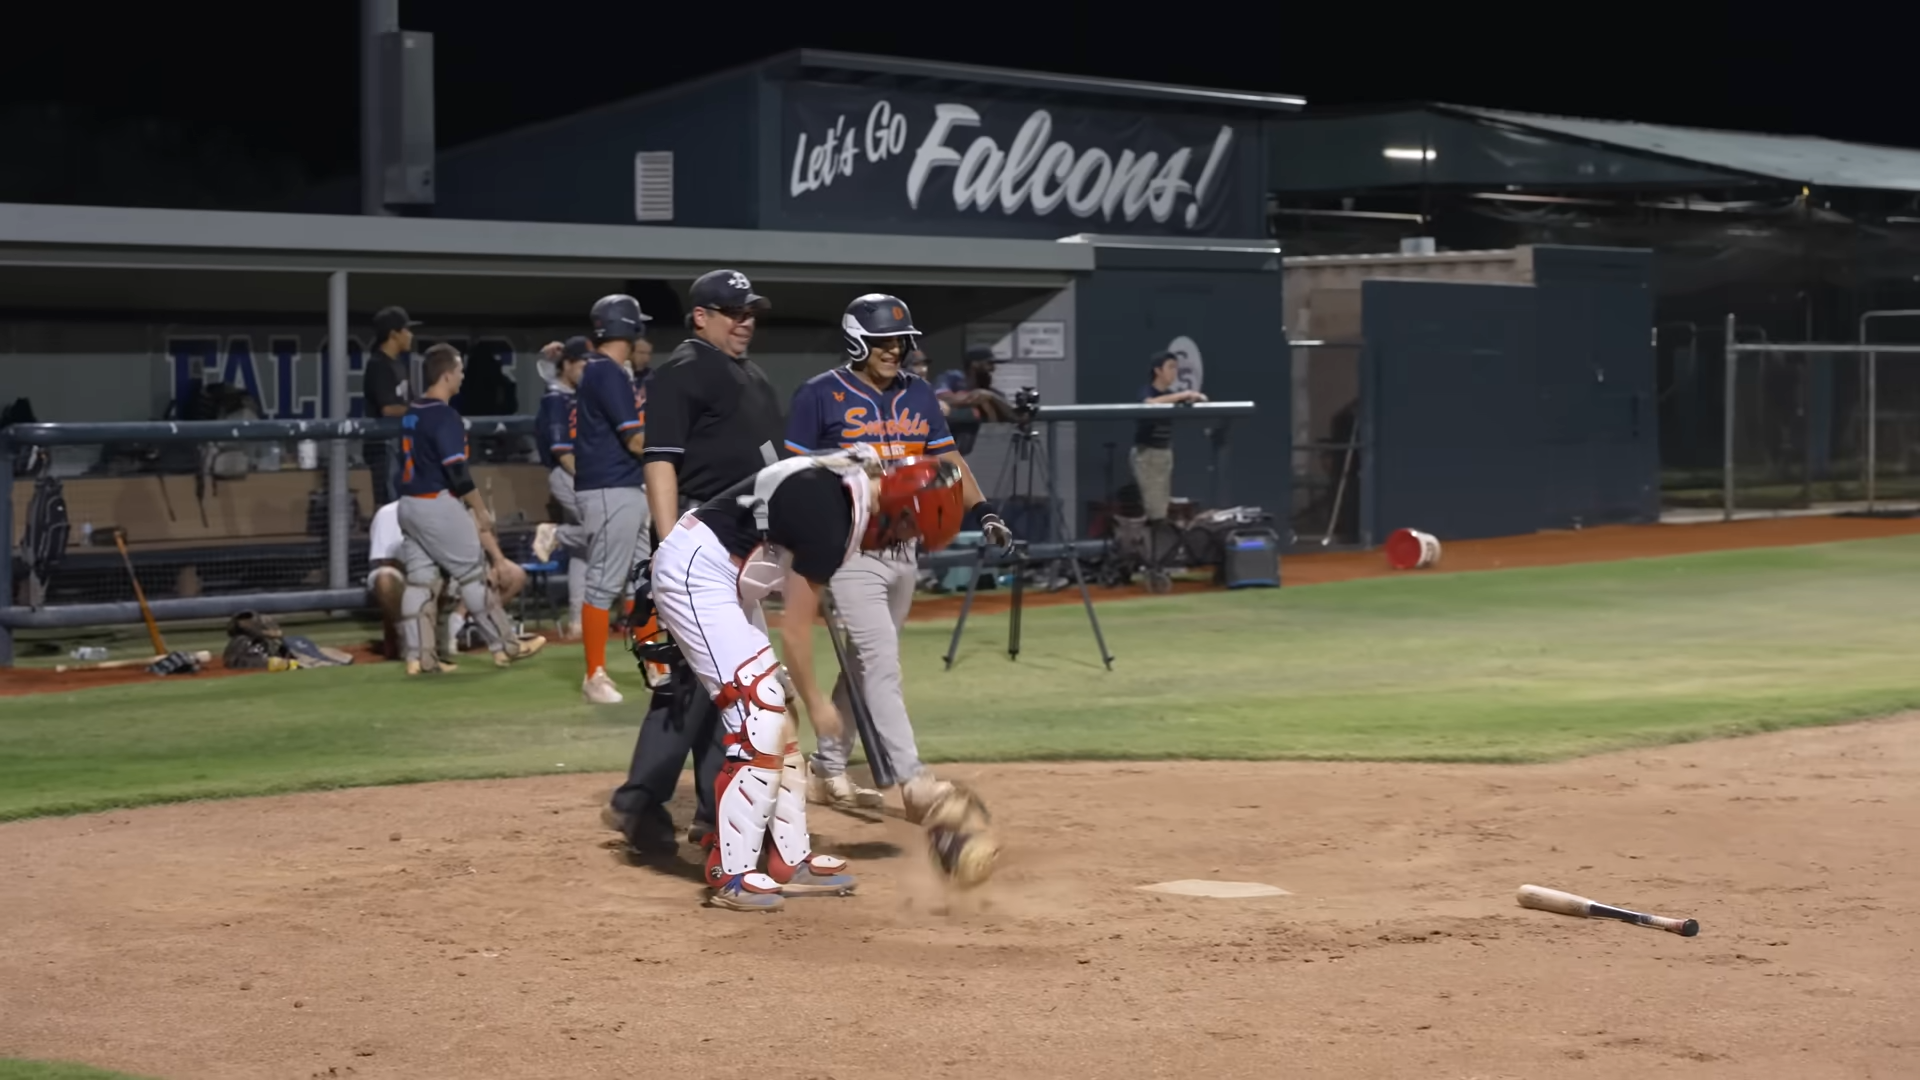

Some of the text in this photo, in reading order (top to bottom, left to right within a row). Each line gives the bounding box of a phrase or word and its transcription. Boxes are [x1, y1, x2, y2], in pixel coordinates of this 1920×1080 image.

[790, 100, 1234, 229] Let's Go Falcons!
